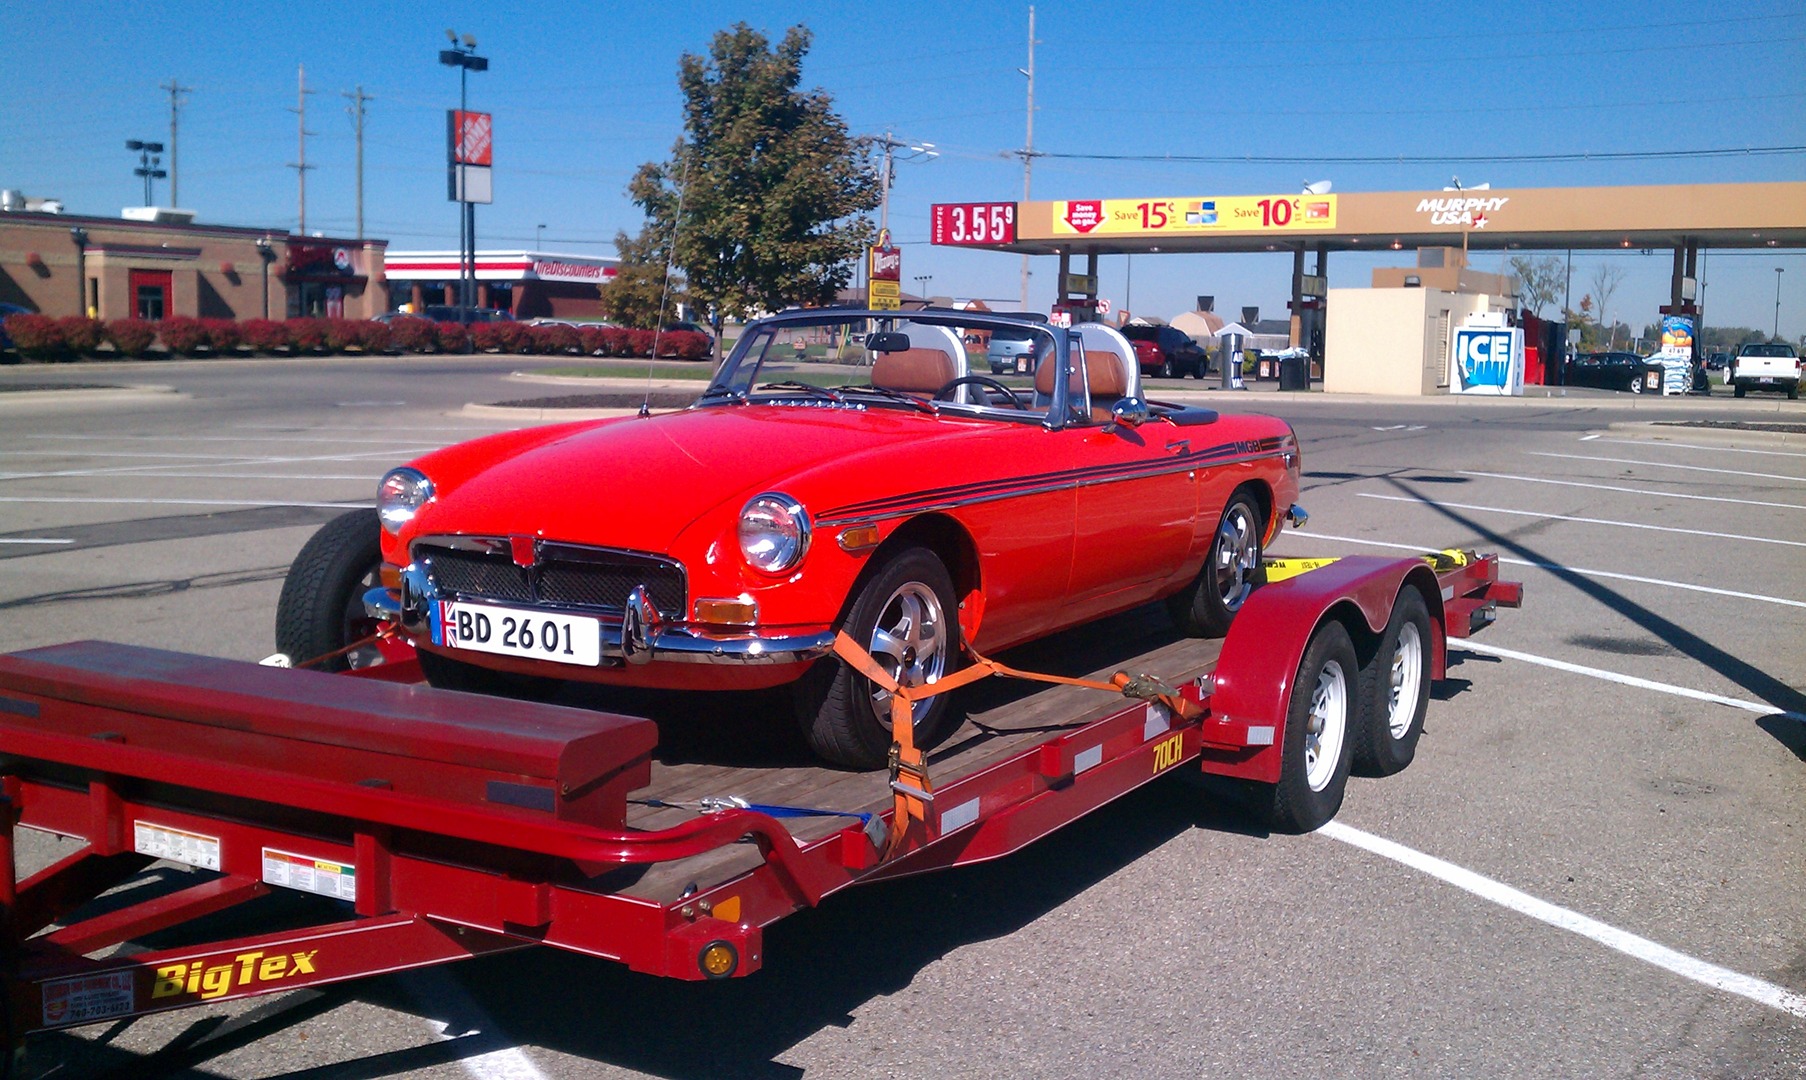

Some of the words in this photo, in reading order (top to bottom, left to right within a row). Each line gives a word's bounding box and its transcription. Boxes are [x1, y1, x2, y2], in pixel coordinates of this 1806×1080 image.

[1075, 204, 1093, 212] Save
[1416, 197, 1509, 212] MURPHY
[1072, 212, 1097, 221] money
[1114, 210, 1139, 221] Save
[1234, 208, 1260, 218] Save
[1431, 211, 1472, 225] USA
[936, 206, 944, 243] UNLEADED
[536, 260, 600, 277] TireDiscounters
[1459, 335, 1509, 362] ICE
[1237, 441, 1260, 453] MGB
[457, 610, 491, 643] BD
[1153, 732, 1183, 774] 70CH
